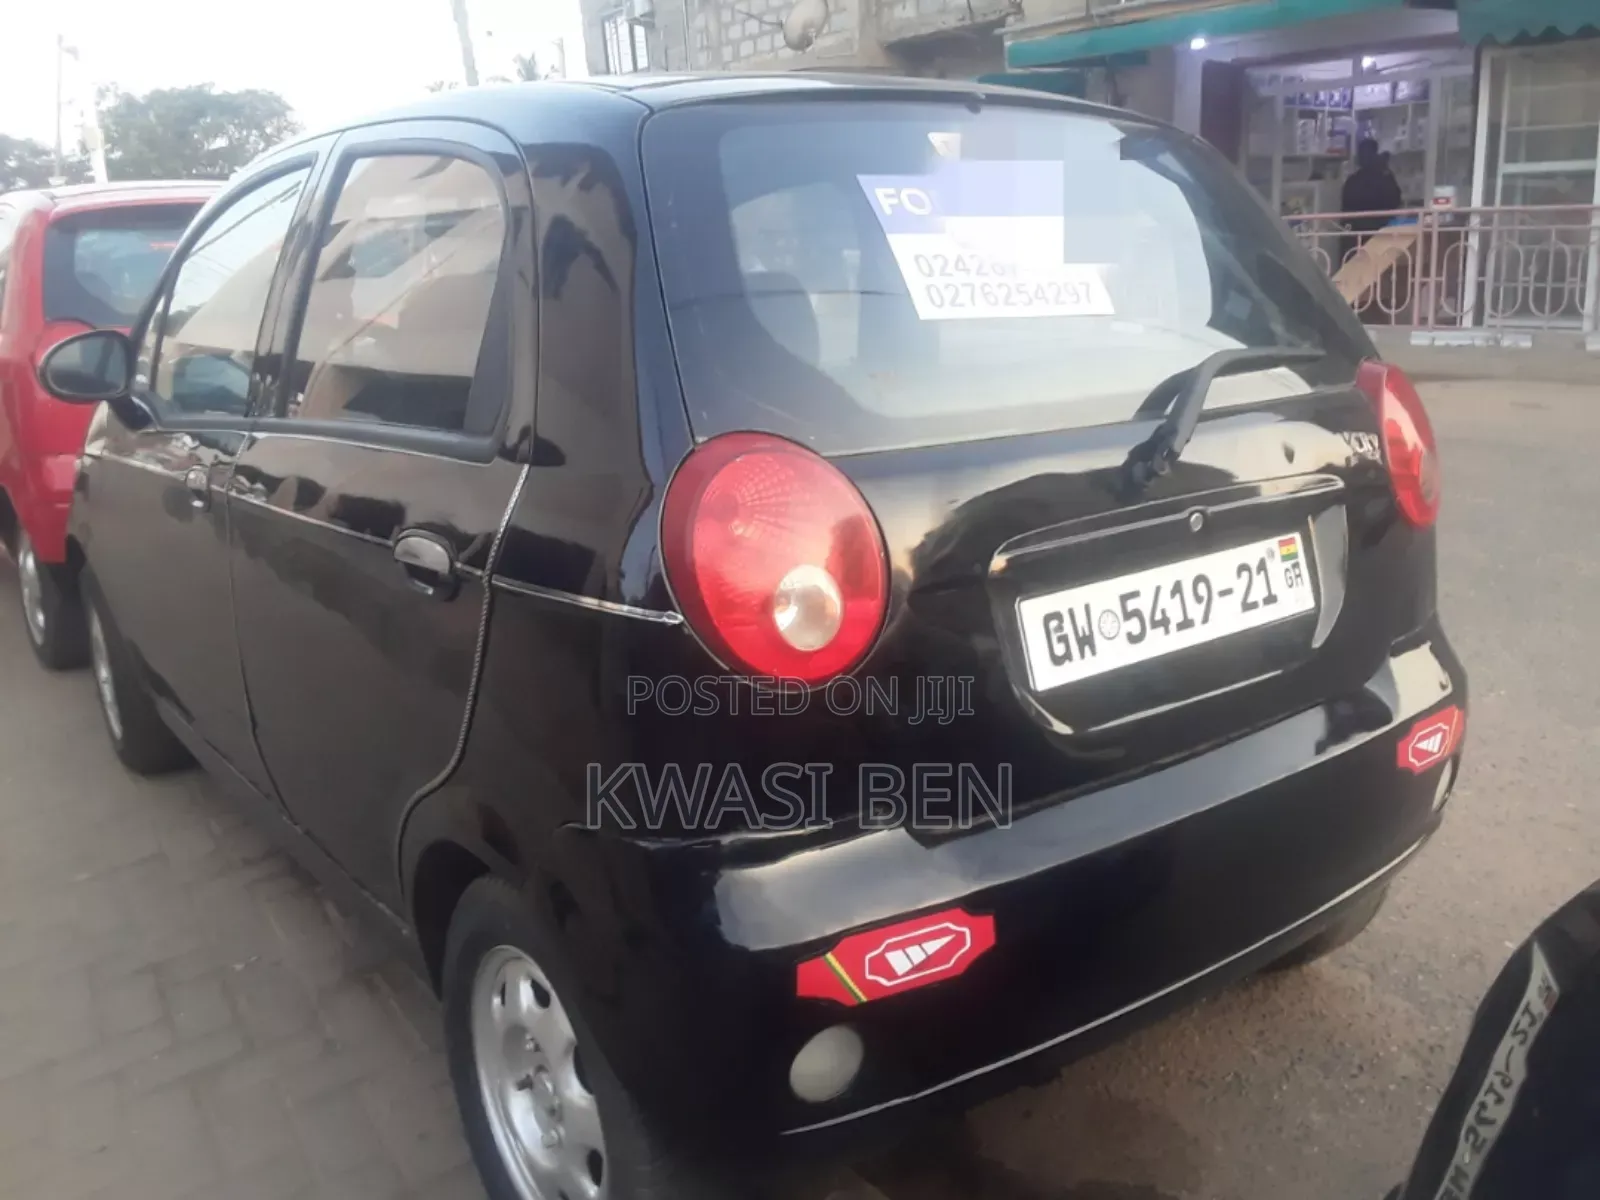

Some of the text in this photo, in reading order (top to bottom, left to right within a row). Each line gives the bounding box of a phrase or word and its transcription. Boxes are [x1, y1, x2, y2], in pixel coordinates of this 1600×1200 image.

[926, 281, 1092, 309] 0276254297
[1043, 557, 1278, 667] GW 5419-21
